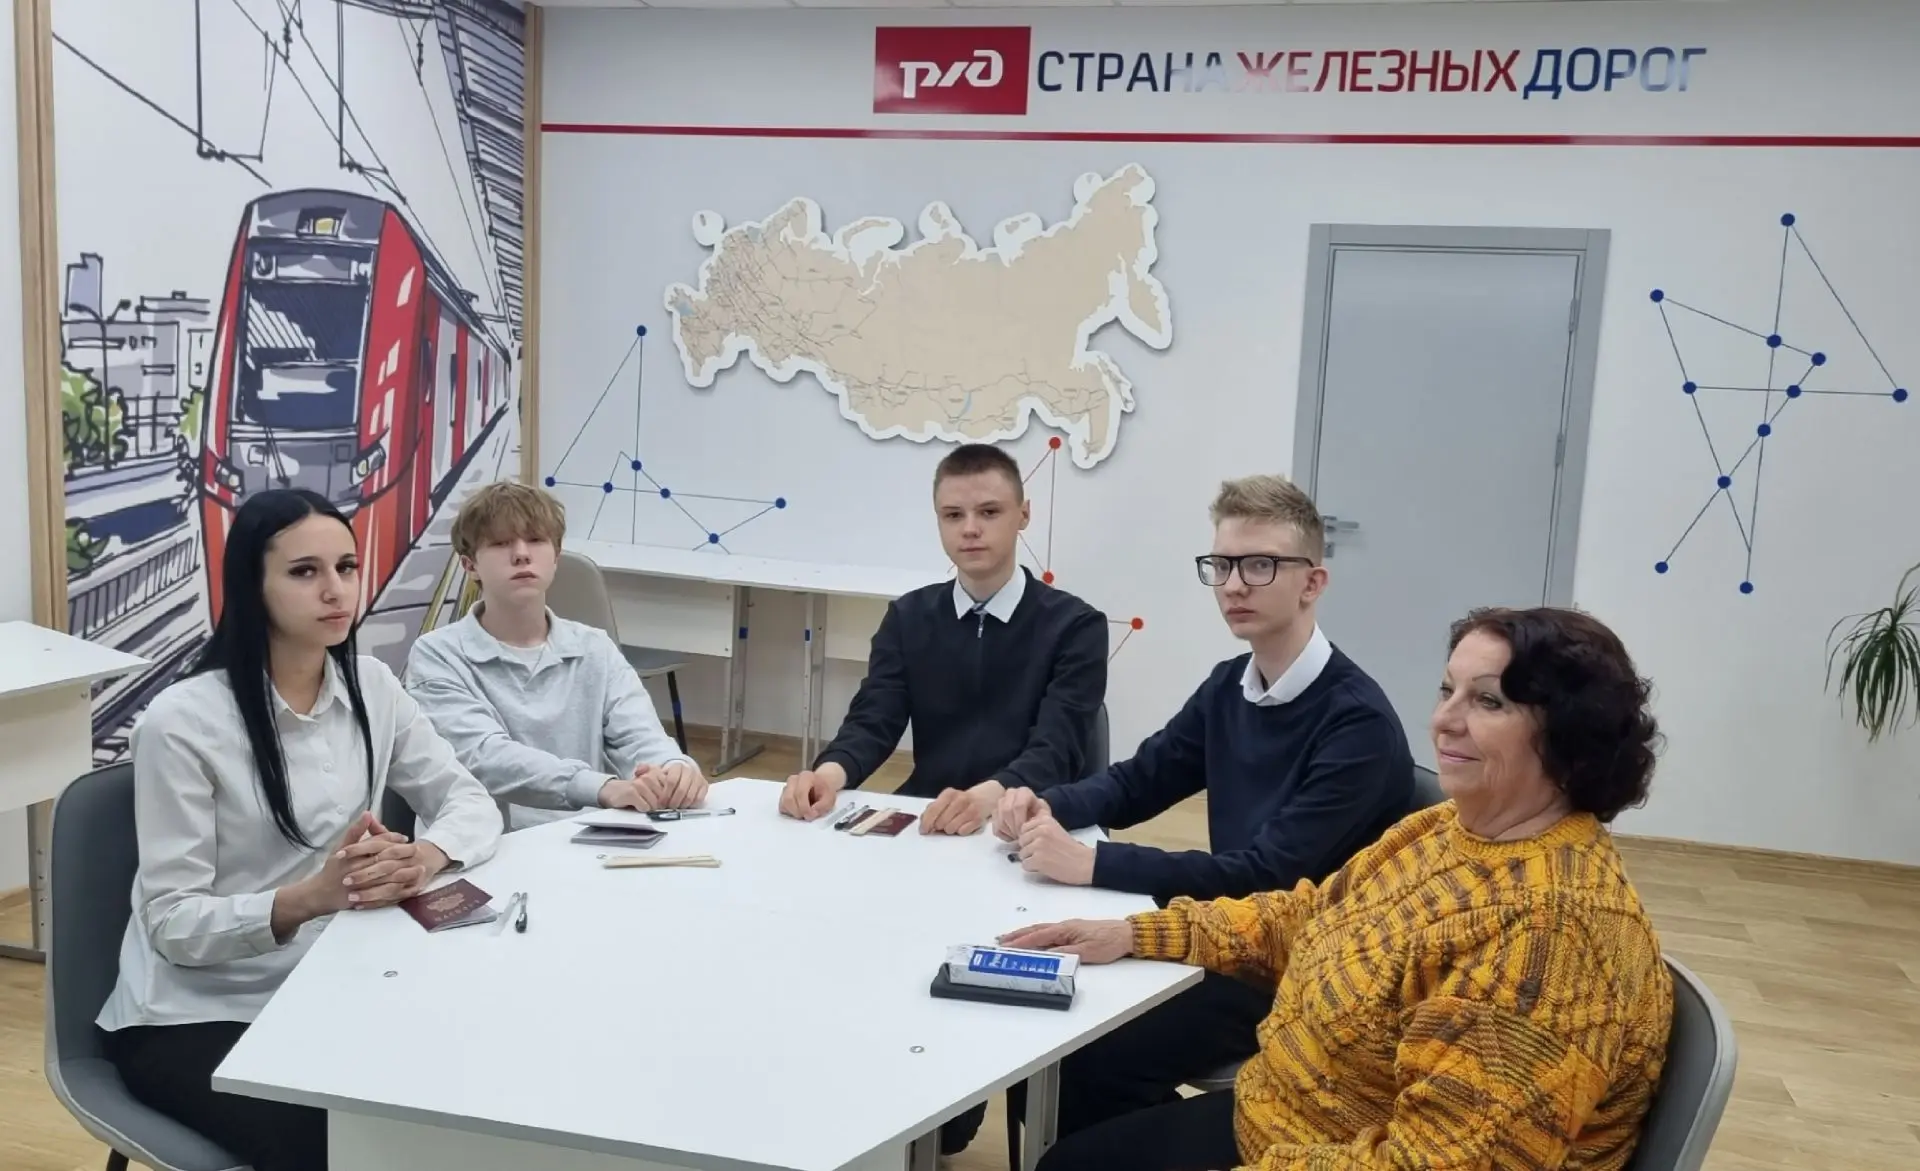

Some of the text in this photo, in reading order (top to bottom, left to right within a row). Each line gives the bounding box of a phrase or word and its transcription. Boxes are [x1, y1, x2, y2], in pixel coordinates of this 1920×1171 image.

[1037, 47, 1708, 100] СТРАНА ЖЕЛЕЗНЫХ ДОРОГ
